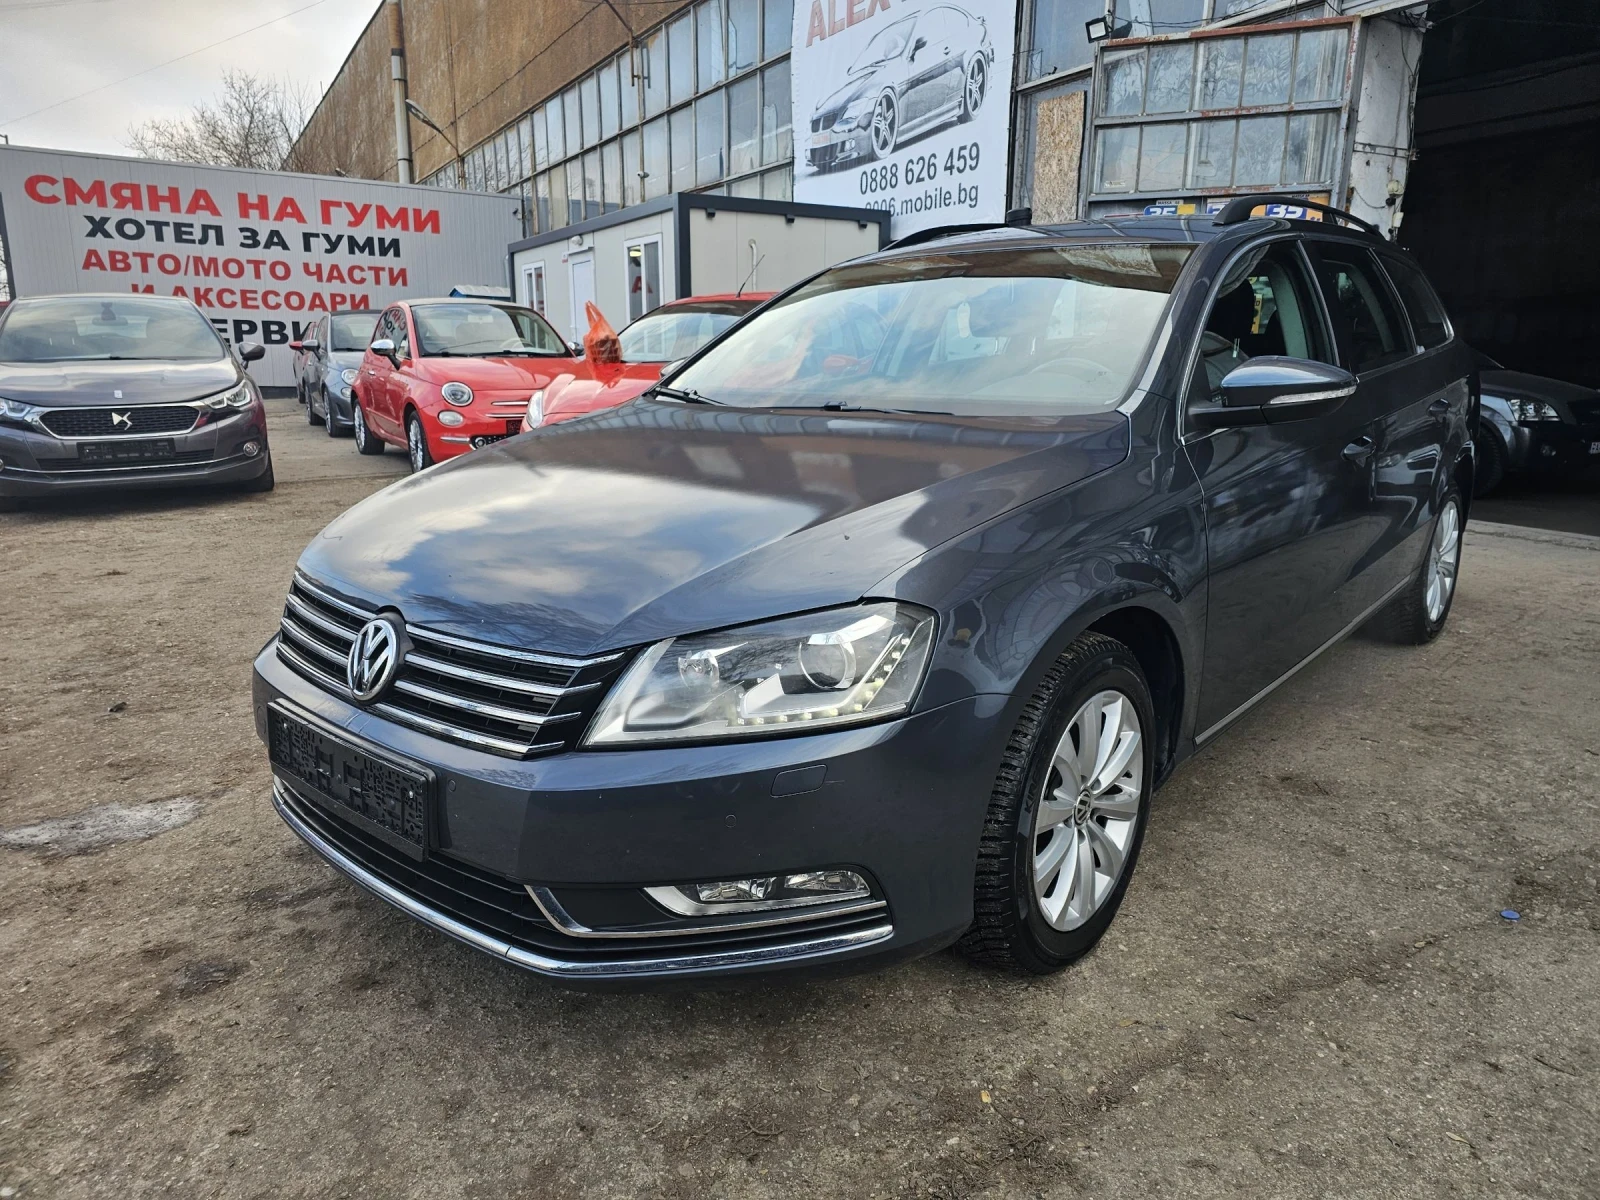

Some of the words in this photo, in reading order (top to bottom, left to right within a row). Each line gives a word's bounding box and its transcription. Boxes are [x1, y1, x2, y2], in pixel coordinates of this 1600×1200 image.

[860, 163, 899, 195] 0888
[905, 153, 938, 185] 626
[943, 142, 980, 176] 459
[24, 174, 223, 217] СМЯНА
[237, 192, 308, 225] НА
[320, 199, 441, 234] ГУМИ
[865, 182, 979, 218] 06.mobile.bg
[83, 215, 225, 246] ХОТЕЛ
[238, 227, 291, 251] ЗА
[302, 232, 401, 258] ГУМИ
[82, 249, 291, 282] АВТО/МОТО
[303, 262, 408, 287] ЧАСТИ
[172, 285, 370, 312] АКСЕСОАРИ
